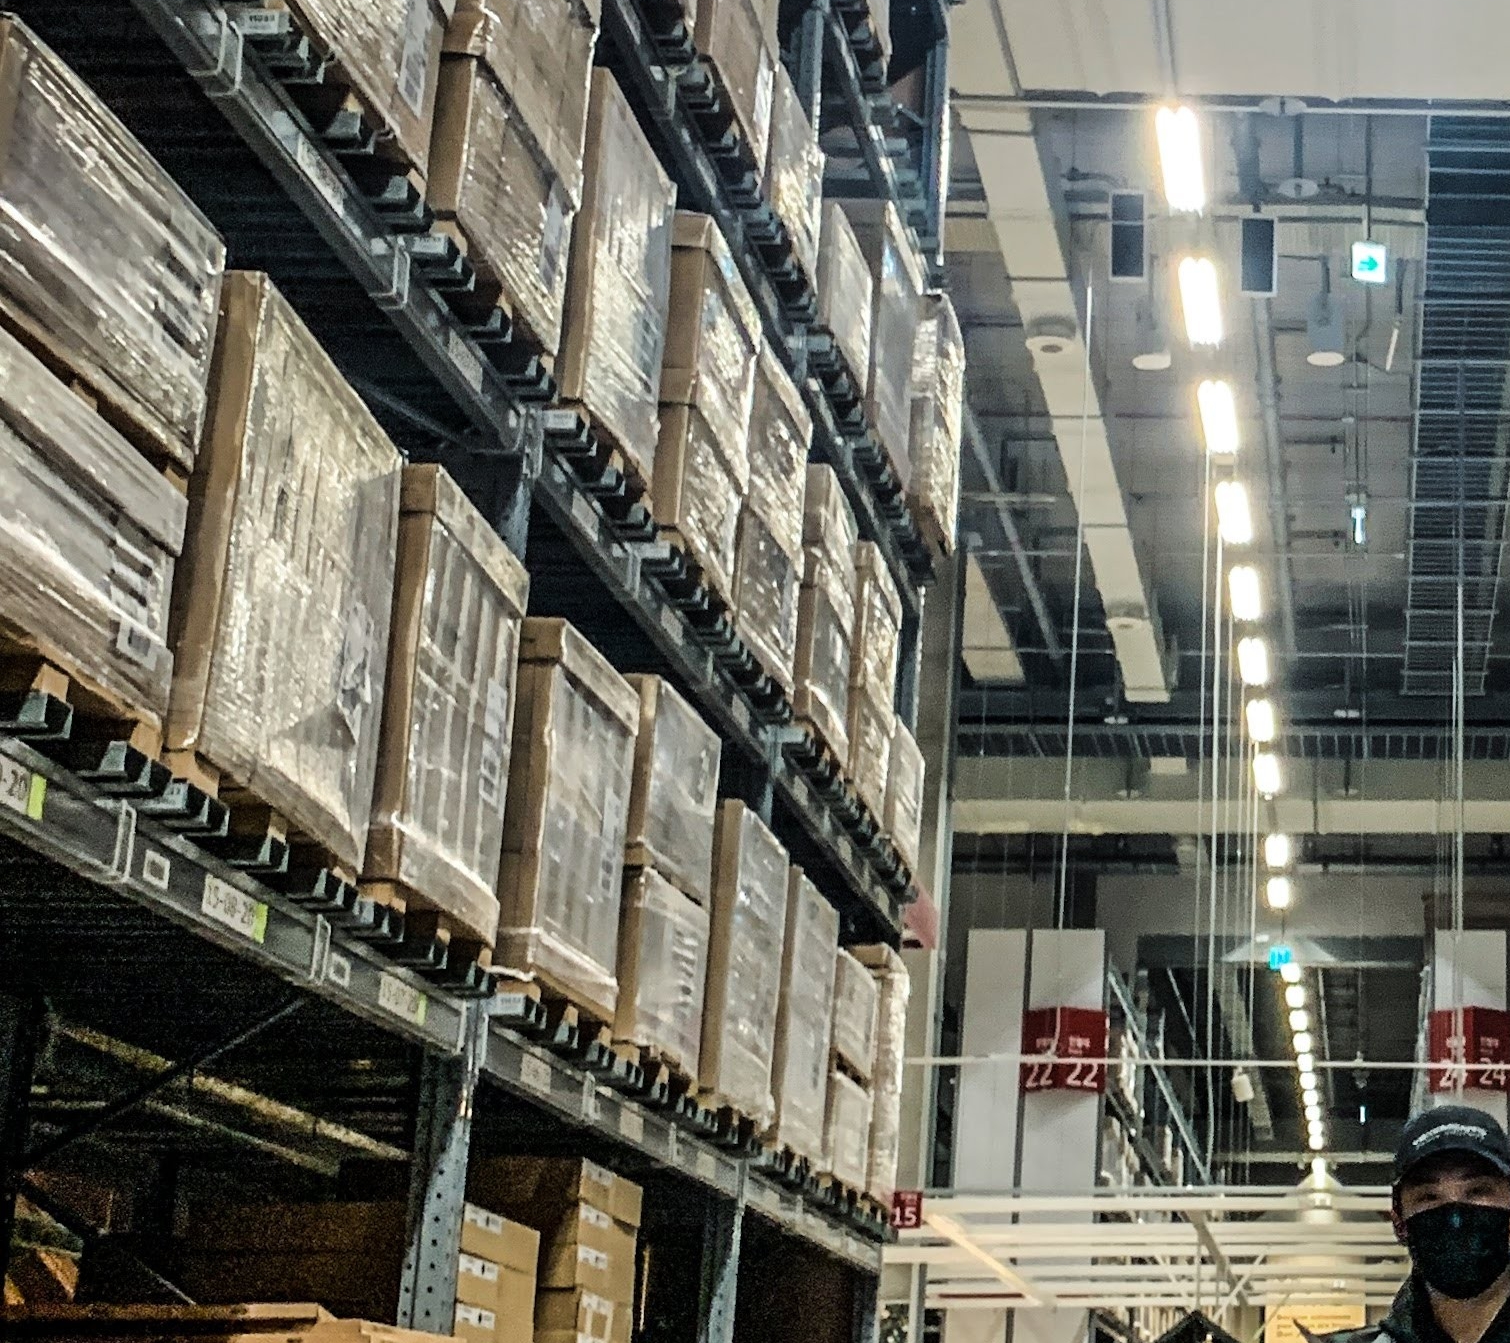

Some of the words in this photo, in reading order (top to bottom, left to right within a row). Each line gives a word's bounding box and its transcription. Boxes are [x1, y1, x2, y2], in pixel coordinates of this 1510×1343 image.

[1025, 1061, 1053, 1088] 22
[1066, 1060, 1098, 1088] 22
[1479, 1057, 1506, 1086] 24
[892, 1206, 917, 1226] 15
